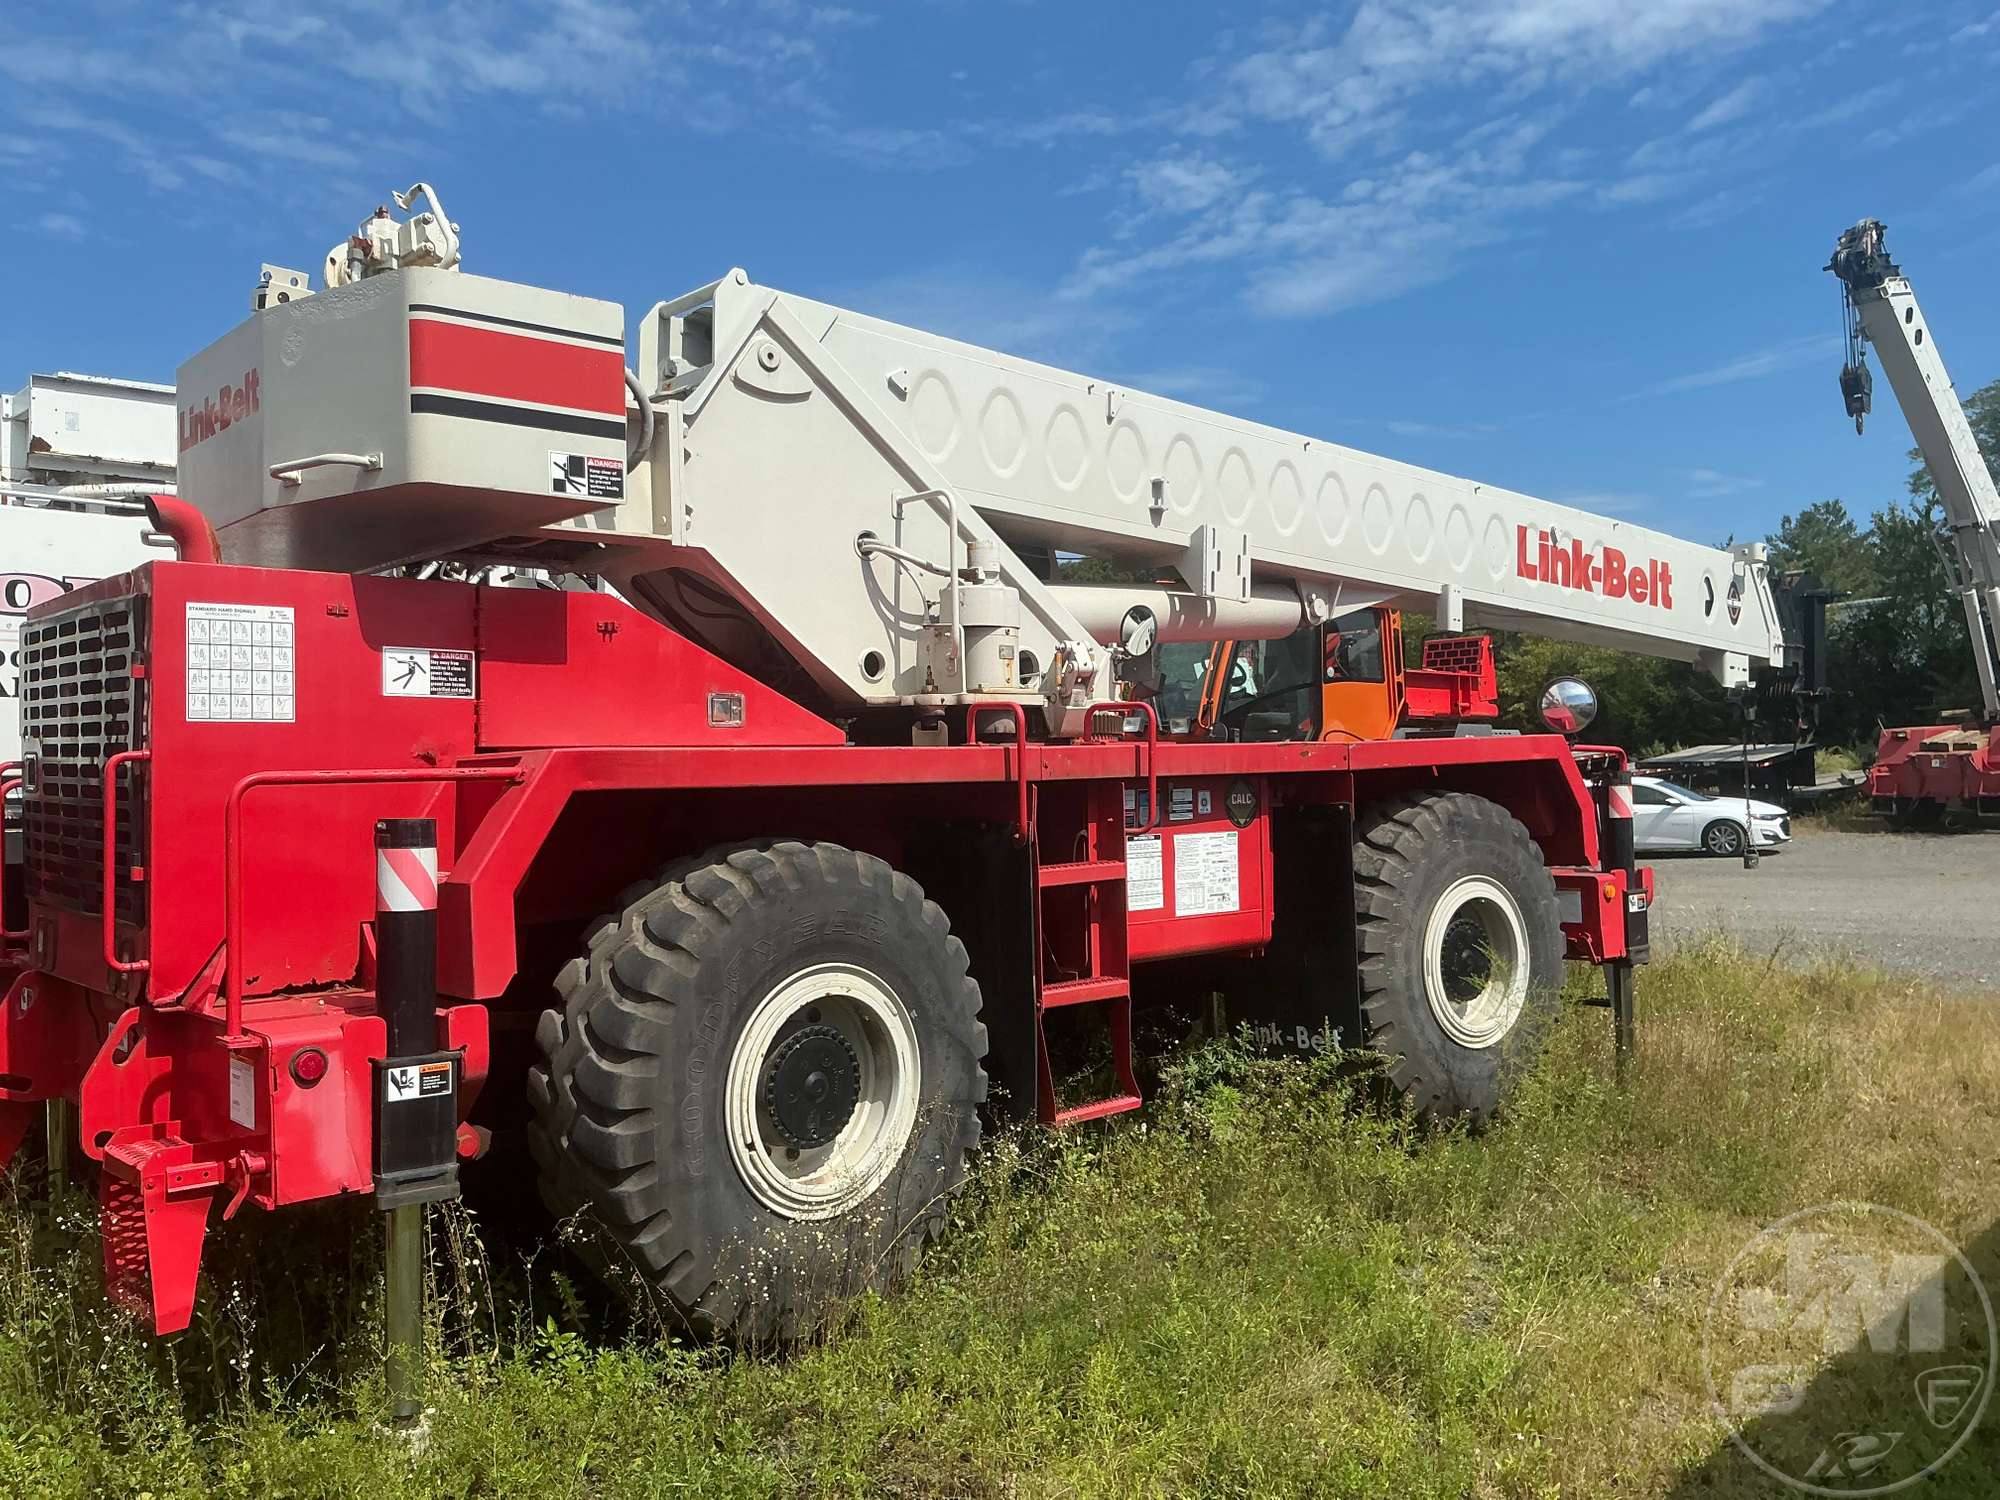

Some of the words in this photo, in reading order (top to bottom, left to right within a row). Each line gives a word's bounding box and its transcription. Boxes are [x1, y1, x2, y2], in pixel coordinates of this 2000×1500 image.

[180, 368, 259, 452] Link-Belt
[594, 459, 624, 470] DANGER
[1516, 524, 1672, 610] Link-Belt
[440, 652, 471, 660] DANGER
[1240, 1019, 1342, 1052] ink-Bet
